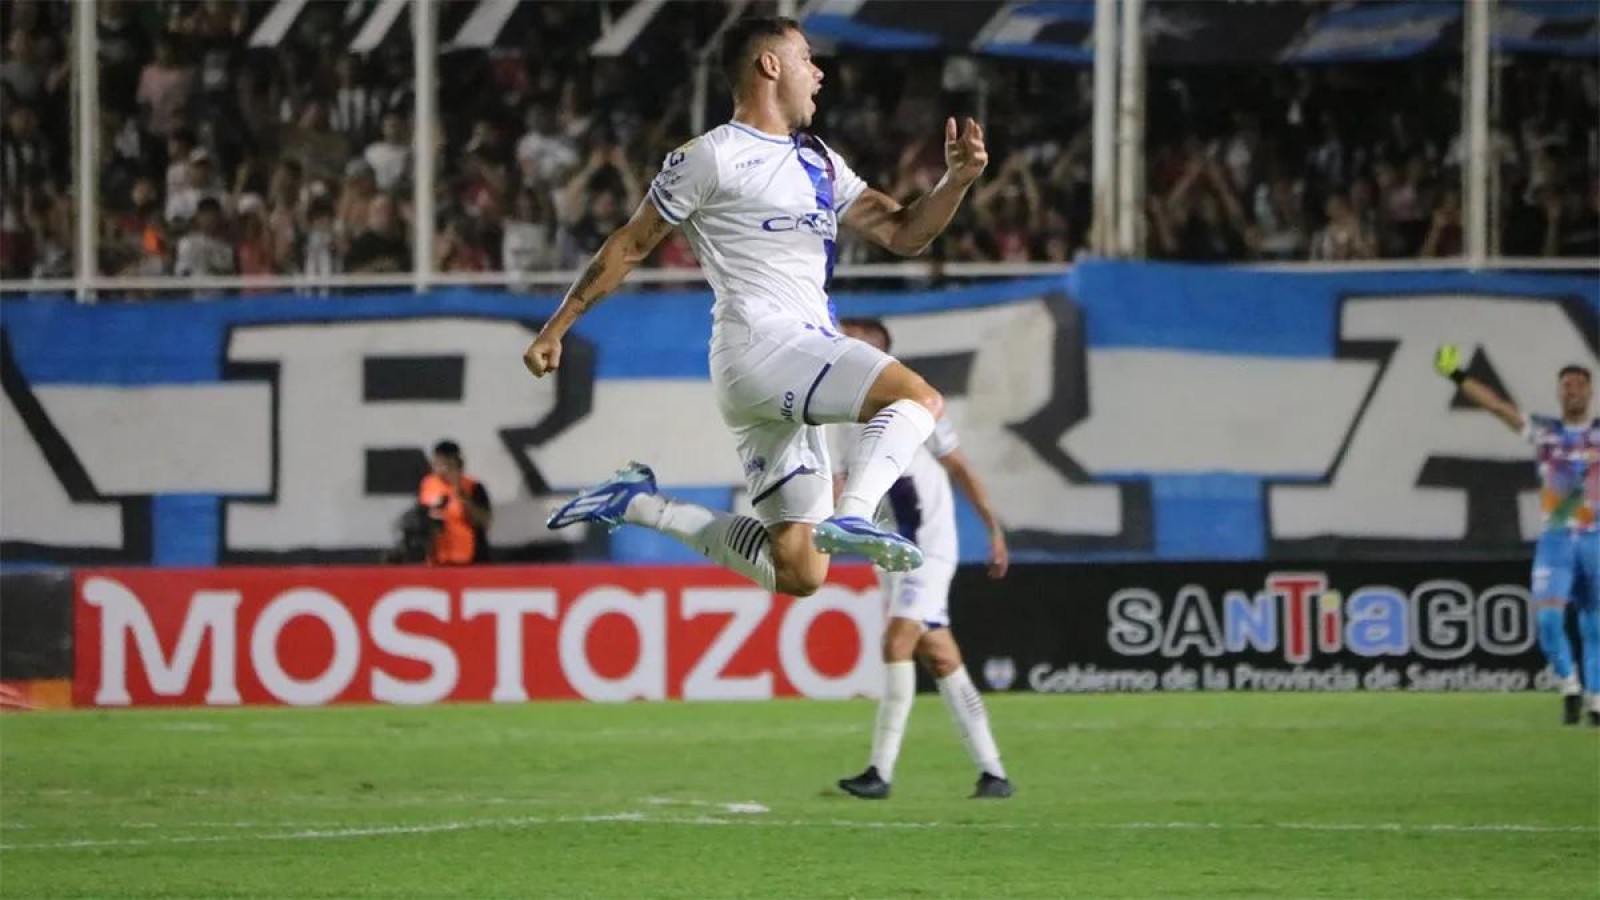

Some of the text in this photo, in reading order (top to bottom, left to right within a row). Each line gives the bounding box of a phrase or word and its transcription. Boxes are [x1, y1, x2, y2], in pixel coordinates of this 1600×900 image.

[1028, 662, 1158, 693] Gobierno
[1161, 663, 1198, 690] de
[1203, 662, 1230, 690] la
[1234, 662, 1358, 690] Provincia
[1363, 662, 1399, 690] de
[1406, 663, 1529, 692] Santiago
